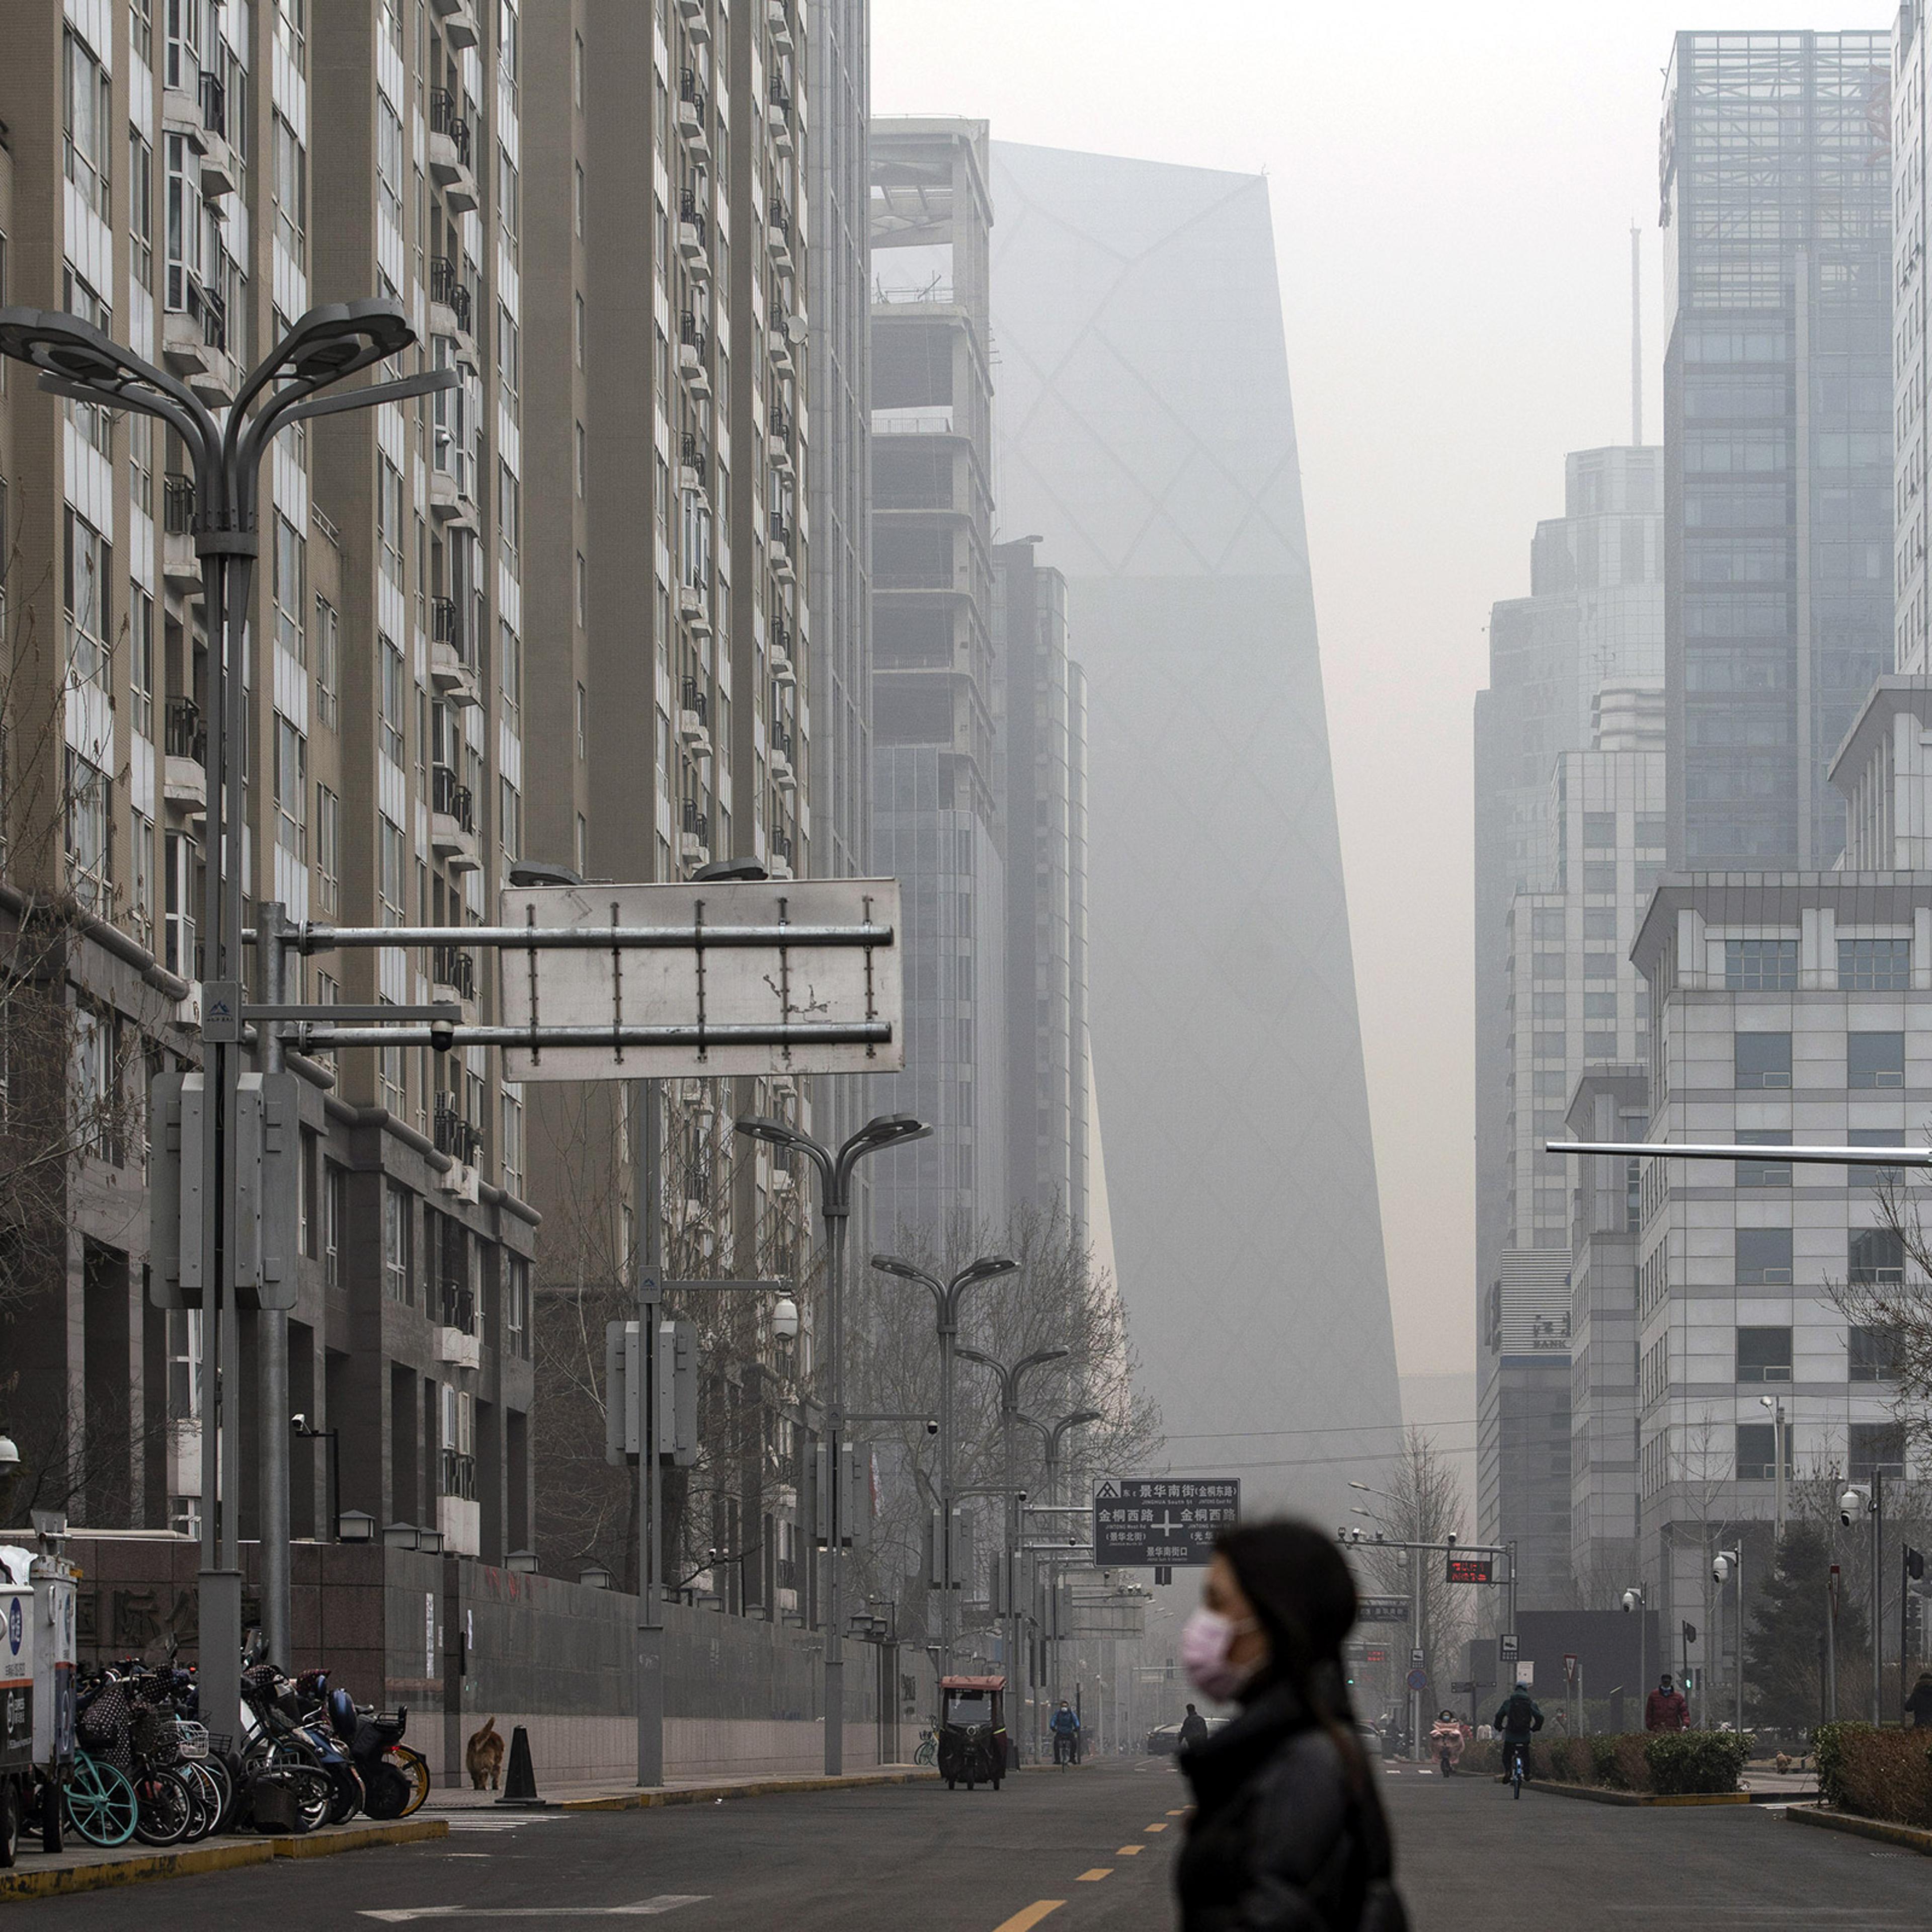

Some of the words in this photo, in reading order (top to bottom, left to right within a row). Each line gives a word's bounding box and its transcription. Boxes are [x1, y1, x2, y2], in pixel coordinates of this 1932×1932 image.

[1098, 1508, 1154, 1522] 金桐西路
[1180, 1508, 1236, 1522] 金桐西路
[1190, 1531, 1218, 1541] (光华
[1147, 1546, 1188, 1557] 景华南街口
